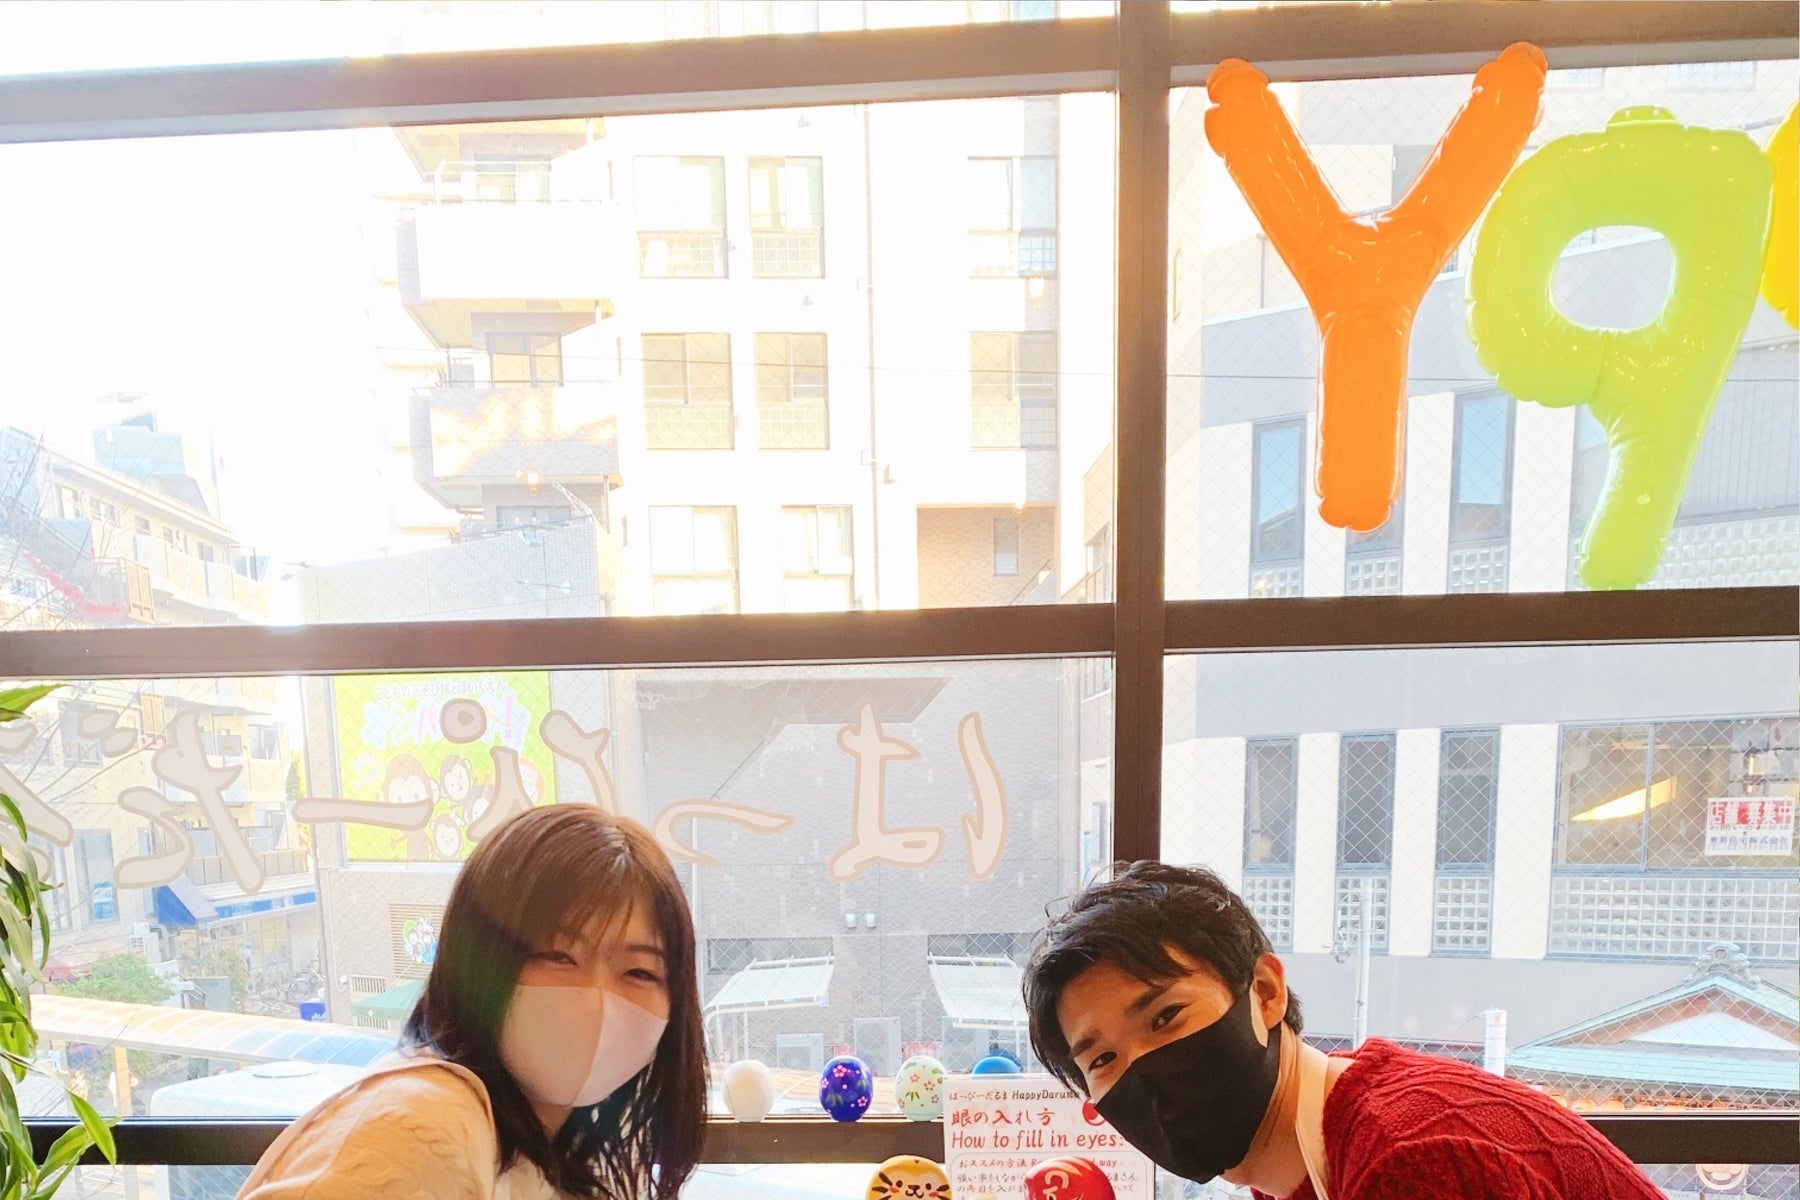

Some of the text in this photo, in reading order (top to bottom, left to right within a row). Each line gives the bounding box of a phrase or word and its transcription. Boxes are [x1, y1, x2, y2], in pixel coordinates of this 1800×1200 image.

[949, 1090, 1008, 1101] はっぴーだるま
[951, 1106, 1056, 1127] 眼の入れ方
[951, 1128, 1124, 1150] How to fill in eyes:
[959, 1158, 1028, 1169] おススメの方法
